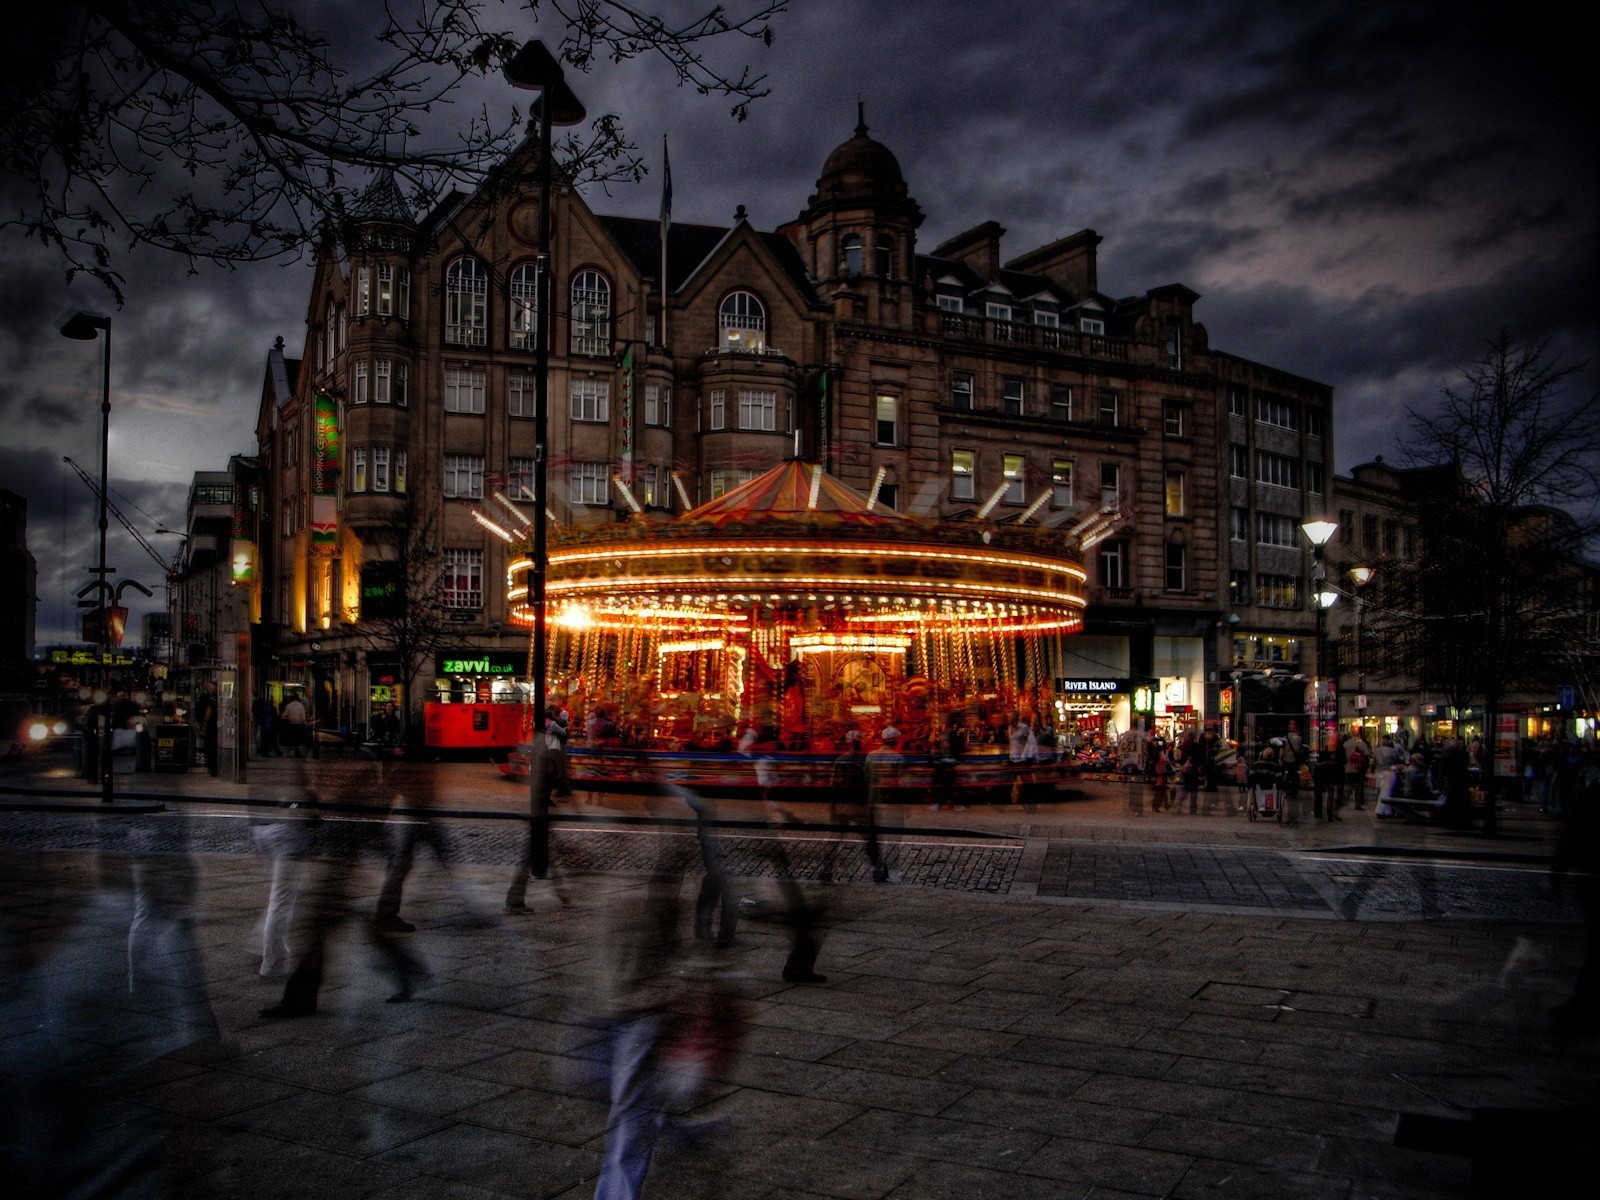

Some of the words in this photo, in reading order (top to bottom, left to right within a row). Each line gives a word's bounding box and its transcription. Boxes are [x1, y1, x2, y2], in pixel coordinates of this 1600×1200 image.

[316, 417, 325, 450] CENTRE
[316, 451, 325, 493] SHOPPING
[443, 655, 514, 673] zavvi.co.uk
[1065, 681, 1087, 690] RIVER
[1089, 681, 1116, 690] ISLAND
[1081, 718, 1102, 731] SALE
